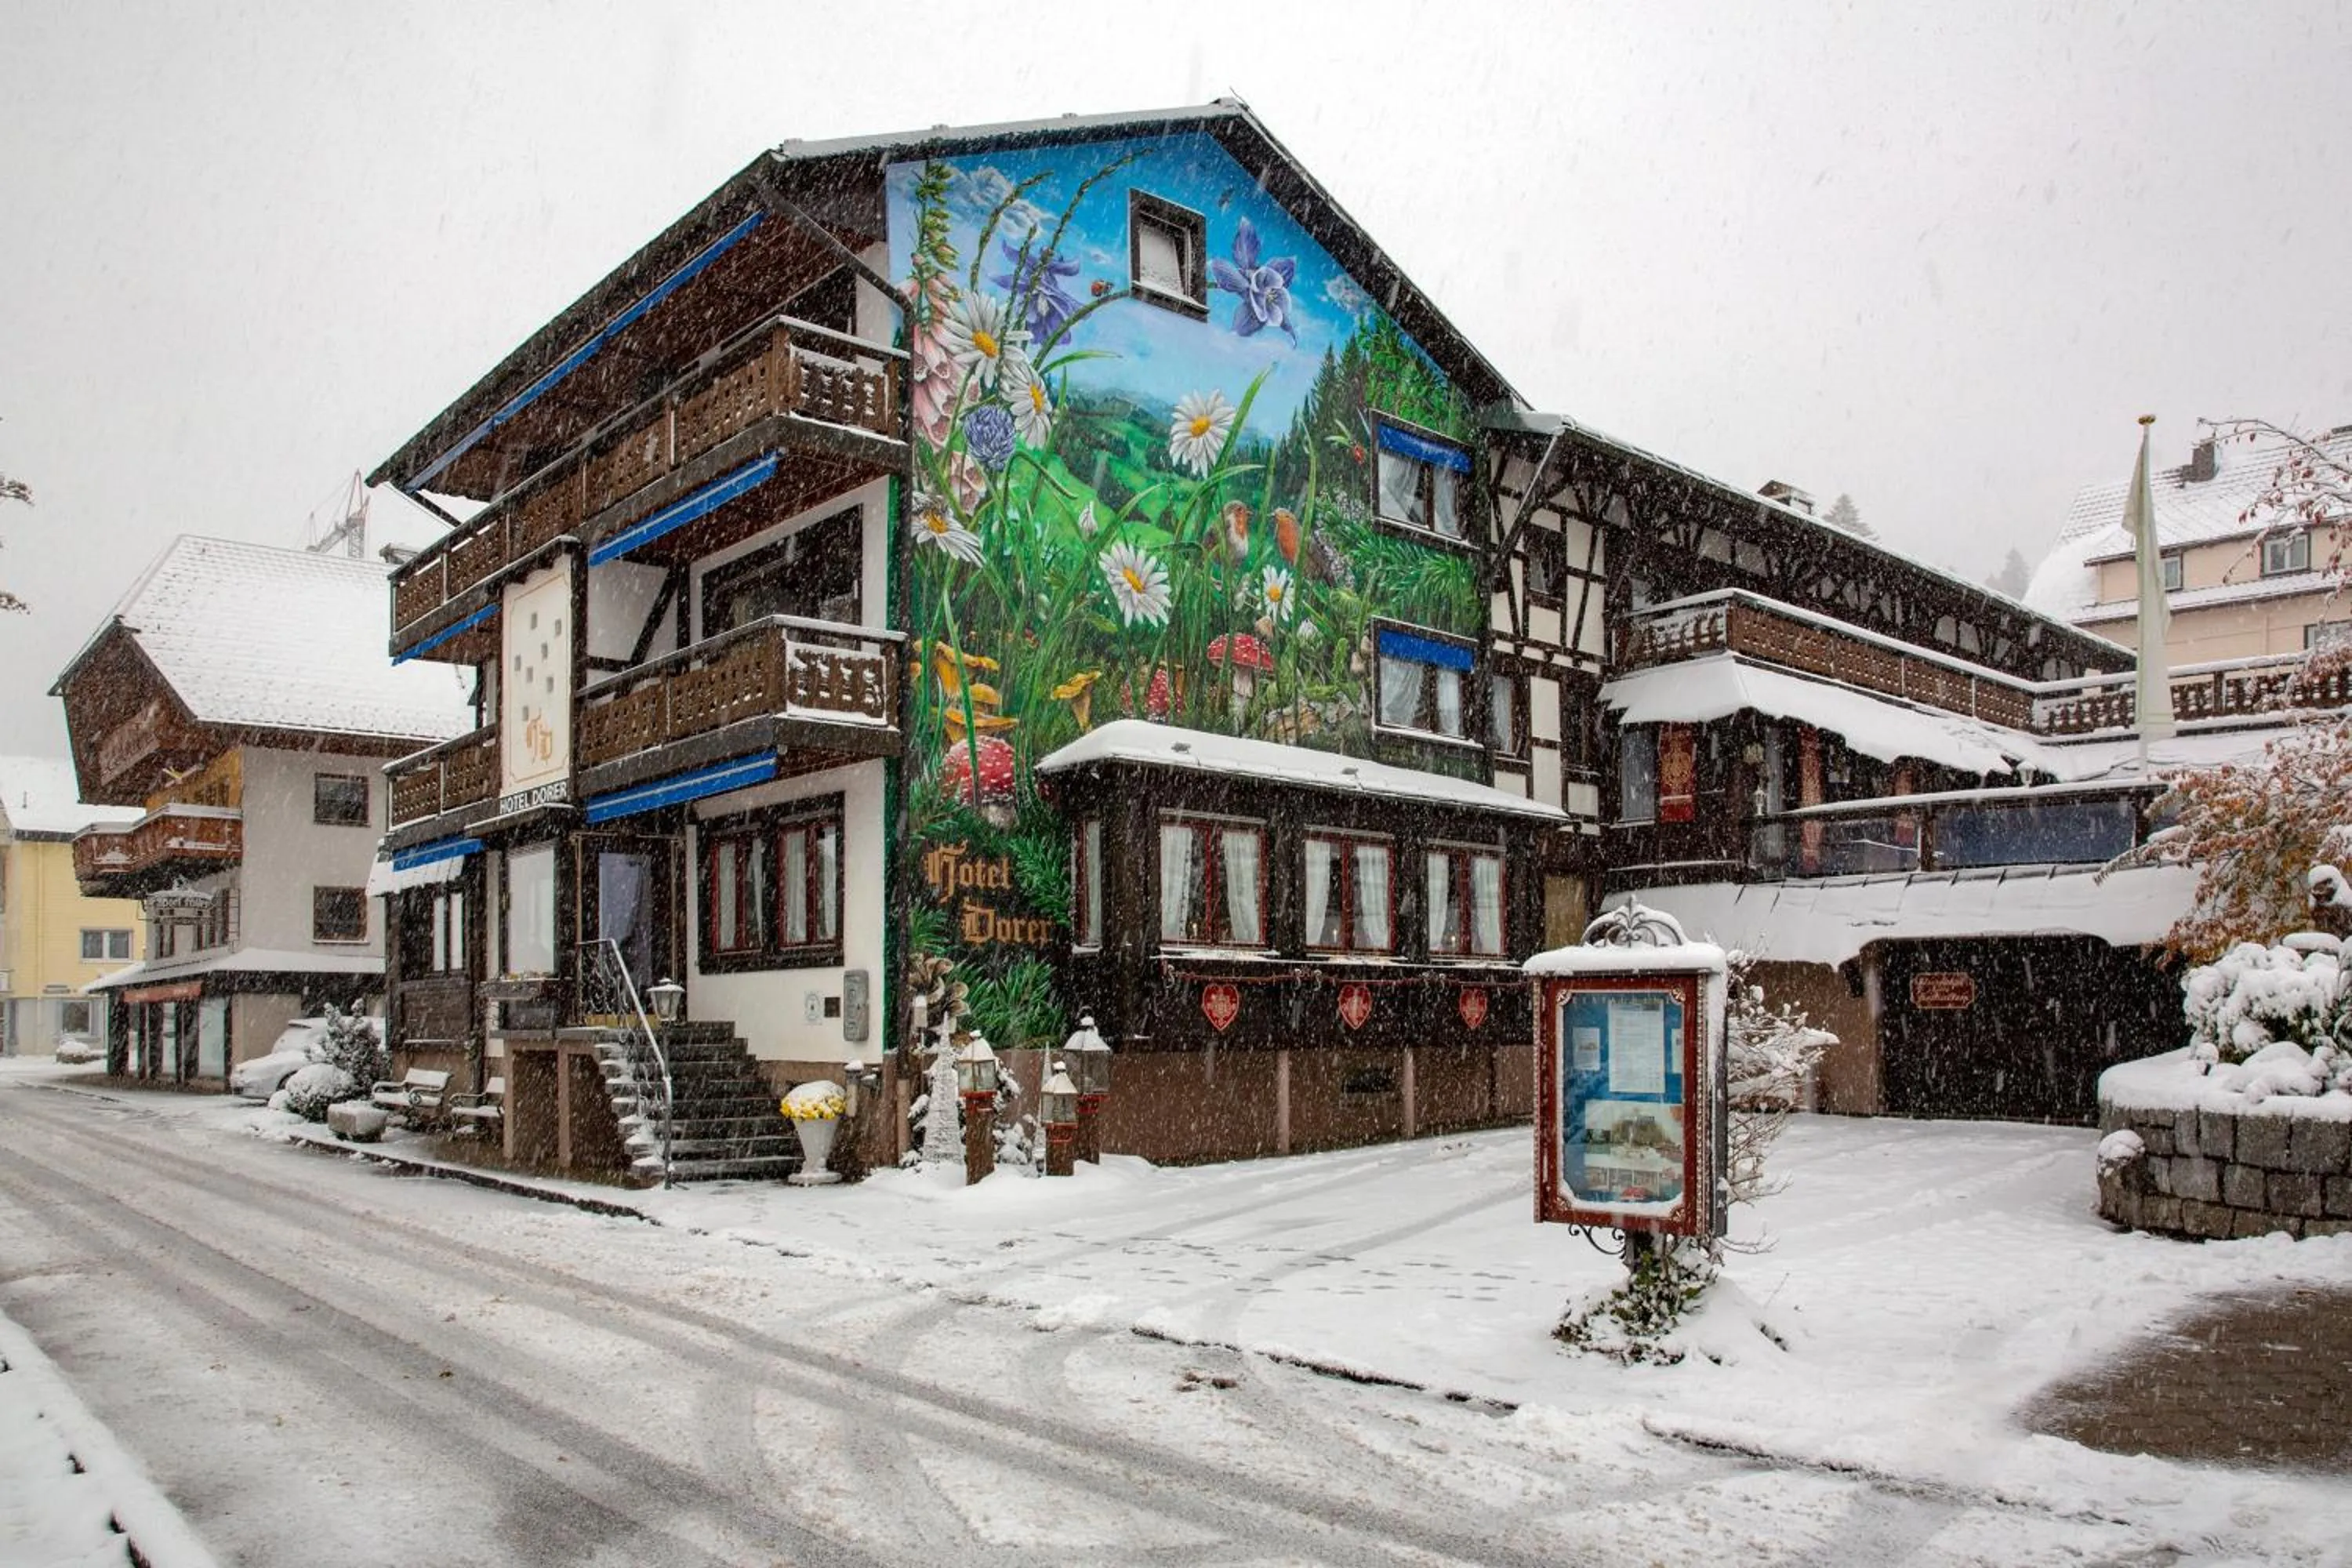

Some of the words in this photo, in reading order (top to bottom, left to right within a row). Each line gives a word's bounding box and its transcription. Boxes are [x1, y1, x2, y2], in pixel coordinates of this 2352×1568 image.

[499, 792, 530, 815] HOTEL
[532, 782, 567, 805] DORER
[924, 839, 1012, 903] Hotel
[961, 896, 1054, 946] Dorer
